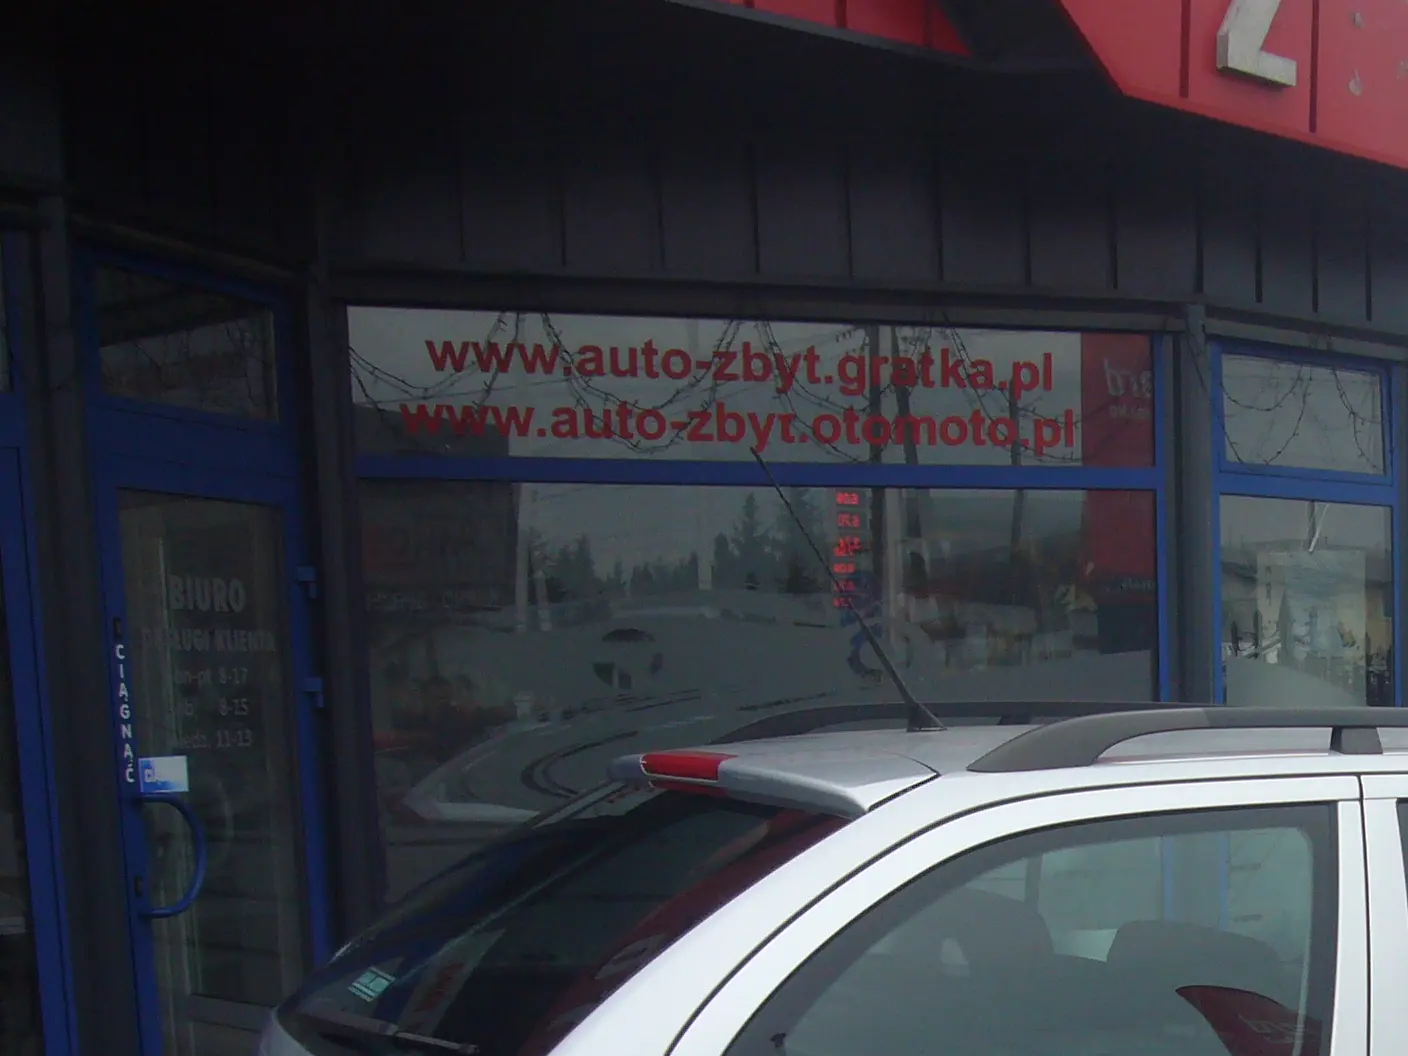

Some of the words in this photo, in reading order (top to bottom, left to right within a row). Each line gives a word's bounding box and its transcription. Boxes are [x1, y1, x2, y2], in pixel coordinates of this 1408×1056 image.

[425, 338, 1053, 399] www.auto-zbyt.gratka.pl
[402, 400, 1075, 457] www.auto-zbyt.otomoto.pl
[168, 574, 247, 613] BIURO
